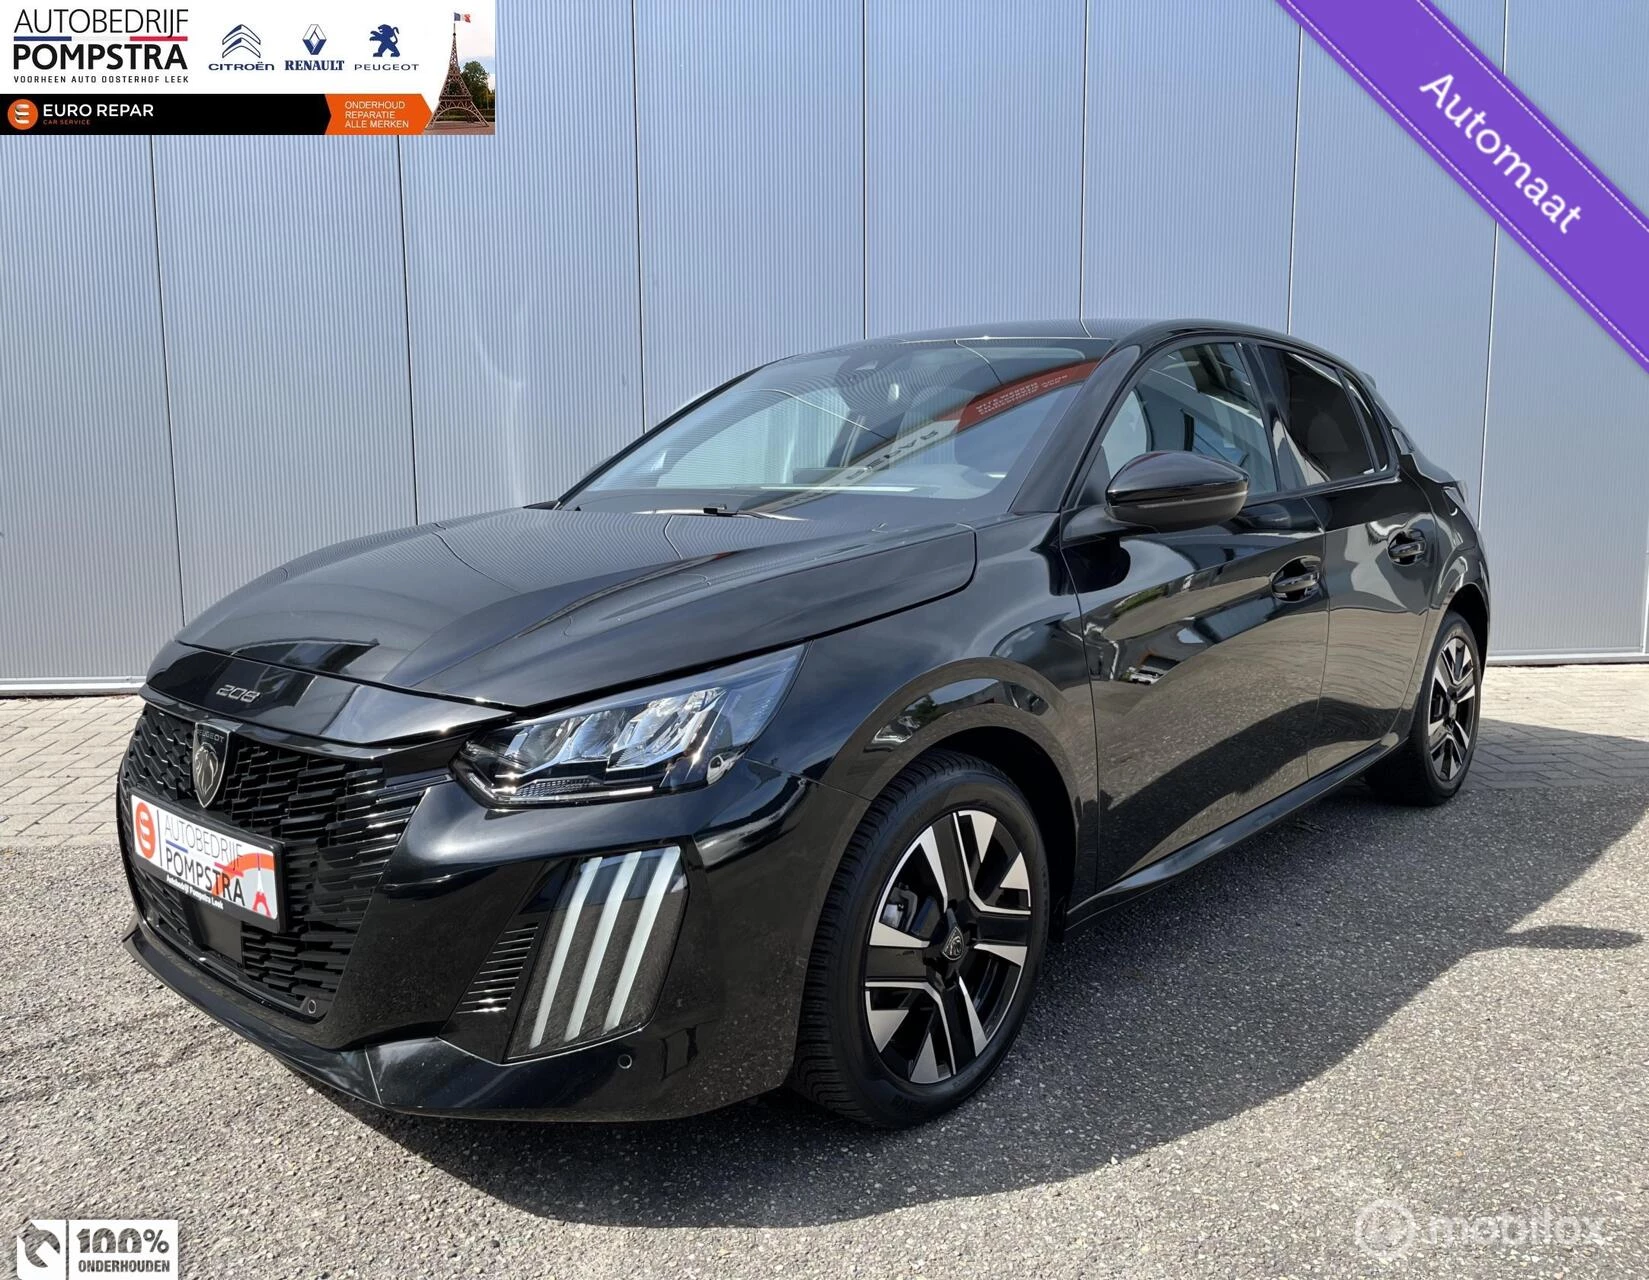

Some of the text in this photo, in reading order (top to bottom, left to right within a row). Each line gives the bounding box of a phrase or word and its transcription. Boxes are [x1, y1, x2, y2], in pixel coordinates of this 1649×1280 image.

[216, 684, 261, 703] 208
[165, 815, 243, 871] AUTOBEDRIJF
[166, 848, 245, 906] POMPSTRA
